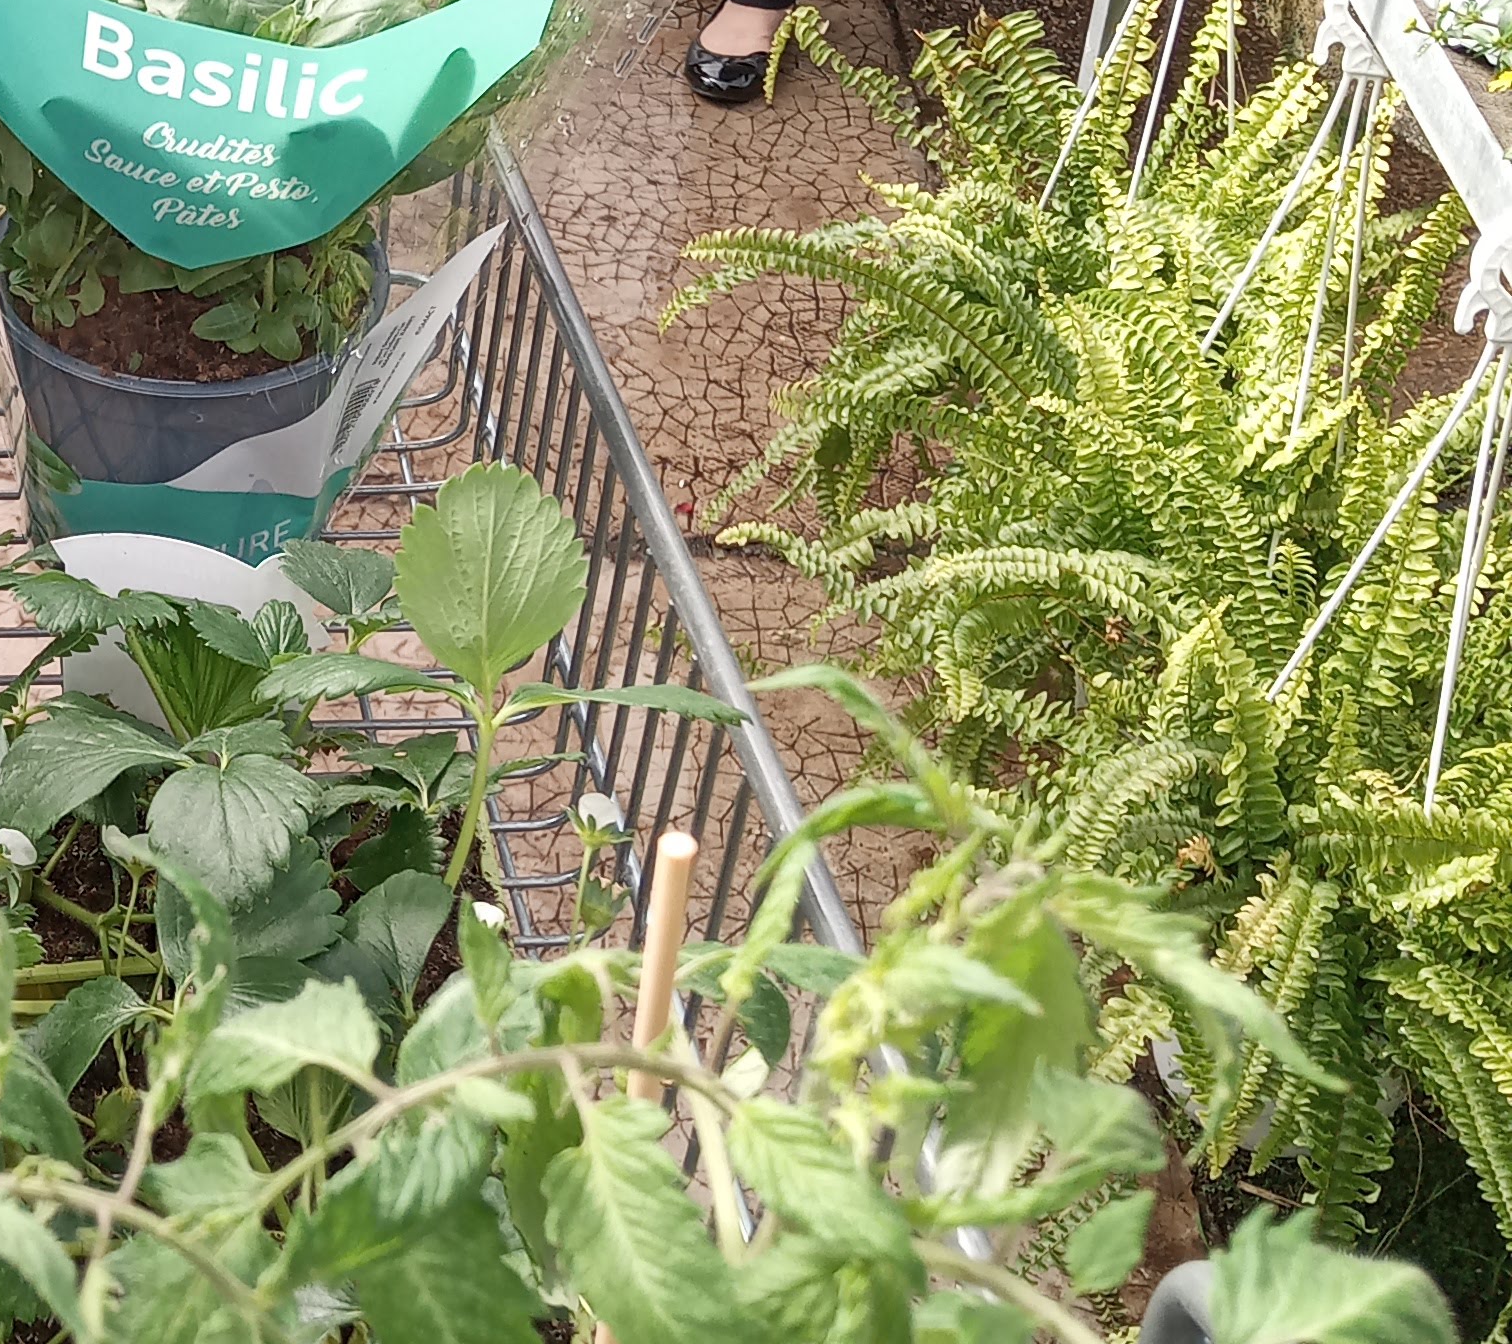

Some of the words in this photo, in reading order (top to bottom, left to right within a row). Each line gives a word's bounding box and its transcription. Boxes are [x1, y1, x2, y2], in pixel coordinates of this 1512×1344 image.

[82, 10, 369, 120] Basilic
[84, 138, 181, 188] Sauce
[185, 169, 225, 196] et
[142, 121, 280, 167] Crudités
[152, 197, 245, 229] Pâtes
